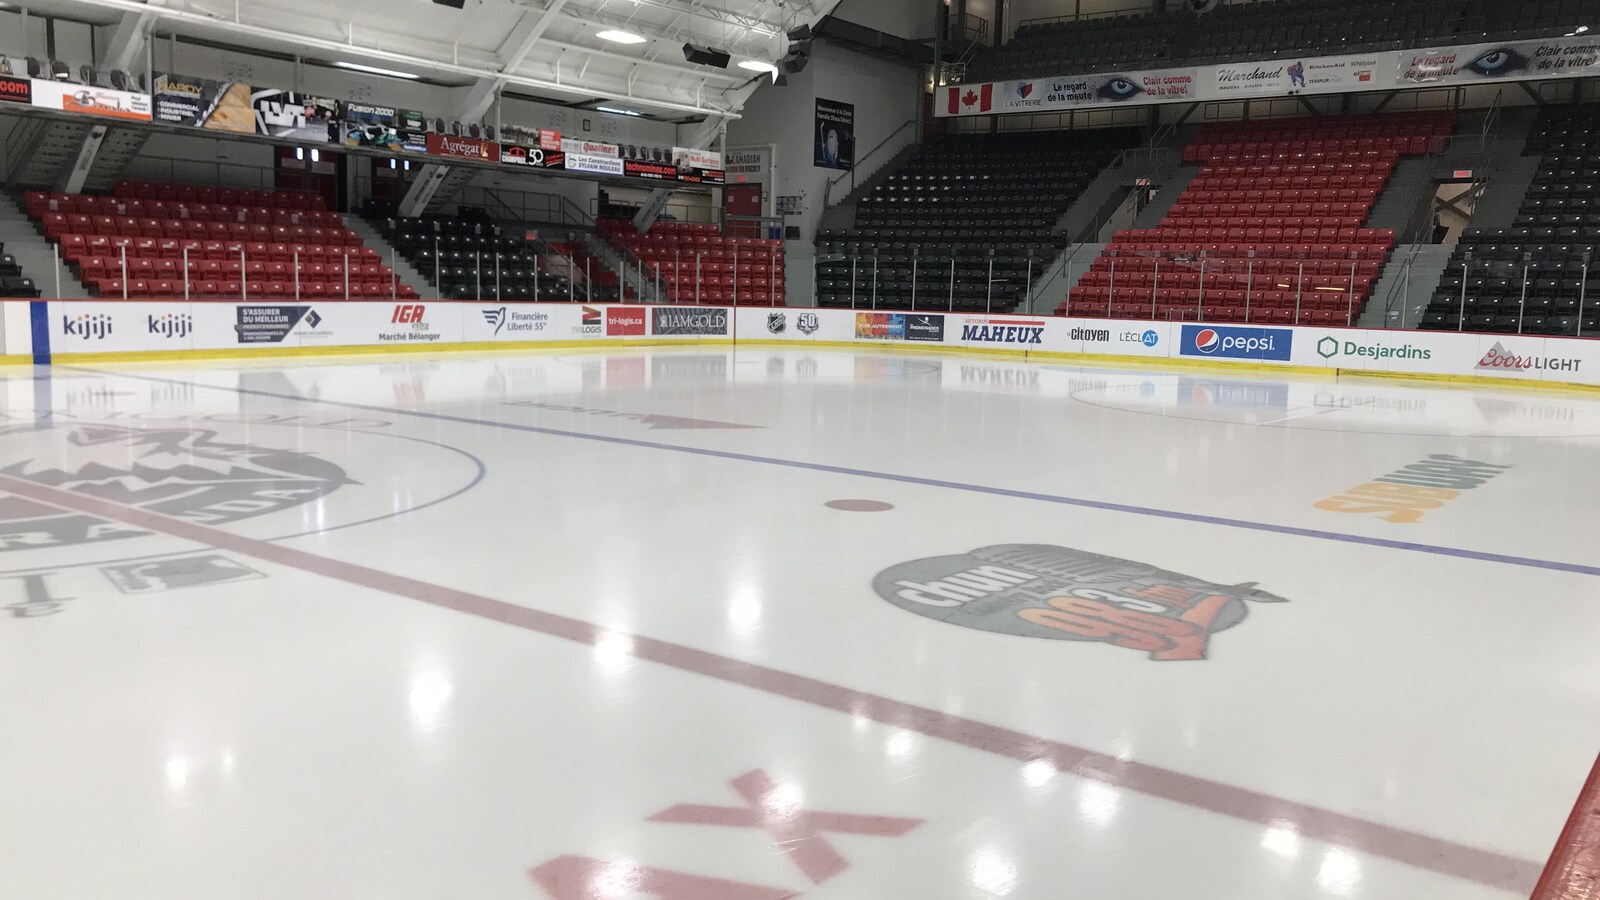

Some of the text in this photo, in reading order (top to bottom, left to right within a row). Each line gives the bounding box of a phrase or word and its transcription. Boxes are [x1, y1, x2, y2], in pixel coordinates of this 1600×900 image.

[1563, 44, 1600, 55] comm
[1411, 53, 1457, 67] Le regard
[1539, 59, 1552, 69] de
[1554, 57, 1565, 68] la
[1142, 75, 1192, 86] Clair comme
[1218, 66, 1284, 82] Marchand
[1053, 81, 1087, 93] Le regard
[1147, 87, 1156, 96] de
[1158, 86, 1166, 95] la
[1047, 91, 1092, 102] de la meute
[348, 103, 395, 117] Fusion 2000
[440, 136, 480, 157] Agrégat
[243, 308, 281, 316] S'ASSURER
[243, 315, 289, 323] DU MEILLEUR
[391, 304, 426, 324] IGA
[511, 311, 549, 321] Financière
[63, 313, 112, 340] kijiji
[148, 313, 192, 338] kijiji
[507, 322, 533, 331] Liberté
[608, 316, 643, 326] tri-logis.ca
[668, 314, 726, 329] IAMGOLD
[800, 312, 816, 327] 50
[378, 331, 441, 342] Marché Bélanger
[961, 324, 1045, 344] MAHEUX
[1070, 326, 1110, 342] citoyen
[1222, 335, 1275, 353] pepsi
[1344, 341, 1432, 360] Desjardins
[1478, 348, 1583, 372] Coors LIGHT
[1312, 453, 1513, 524] SUBWAY
[895, 564, 1041, 608] chun
